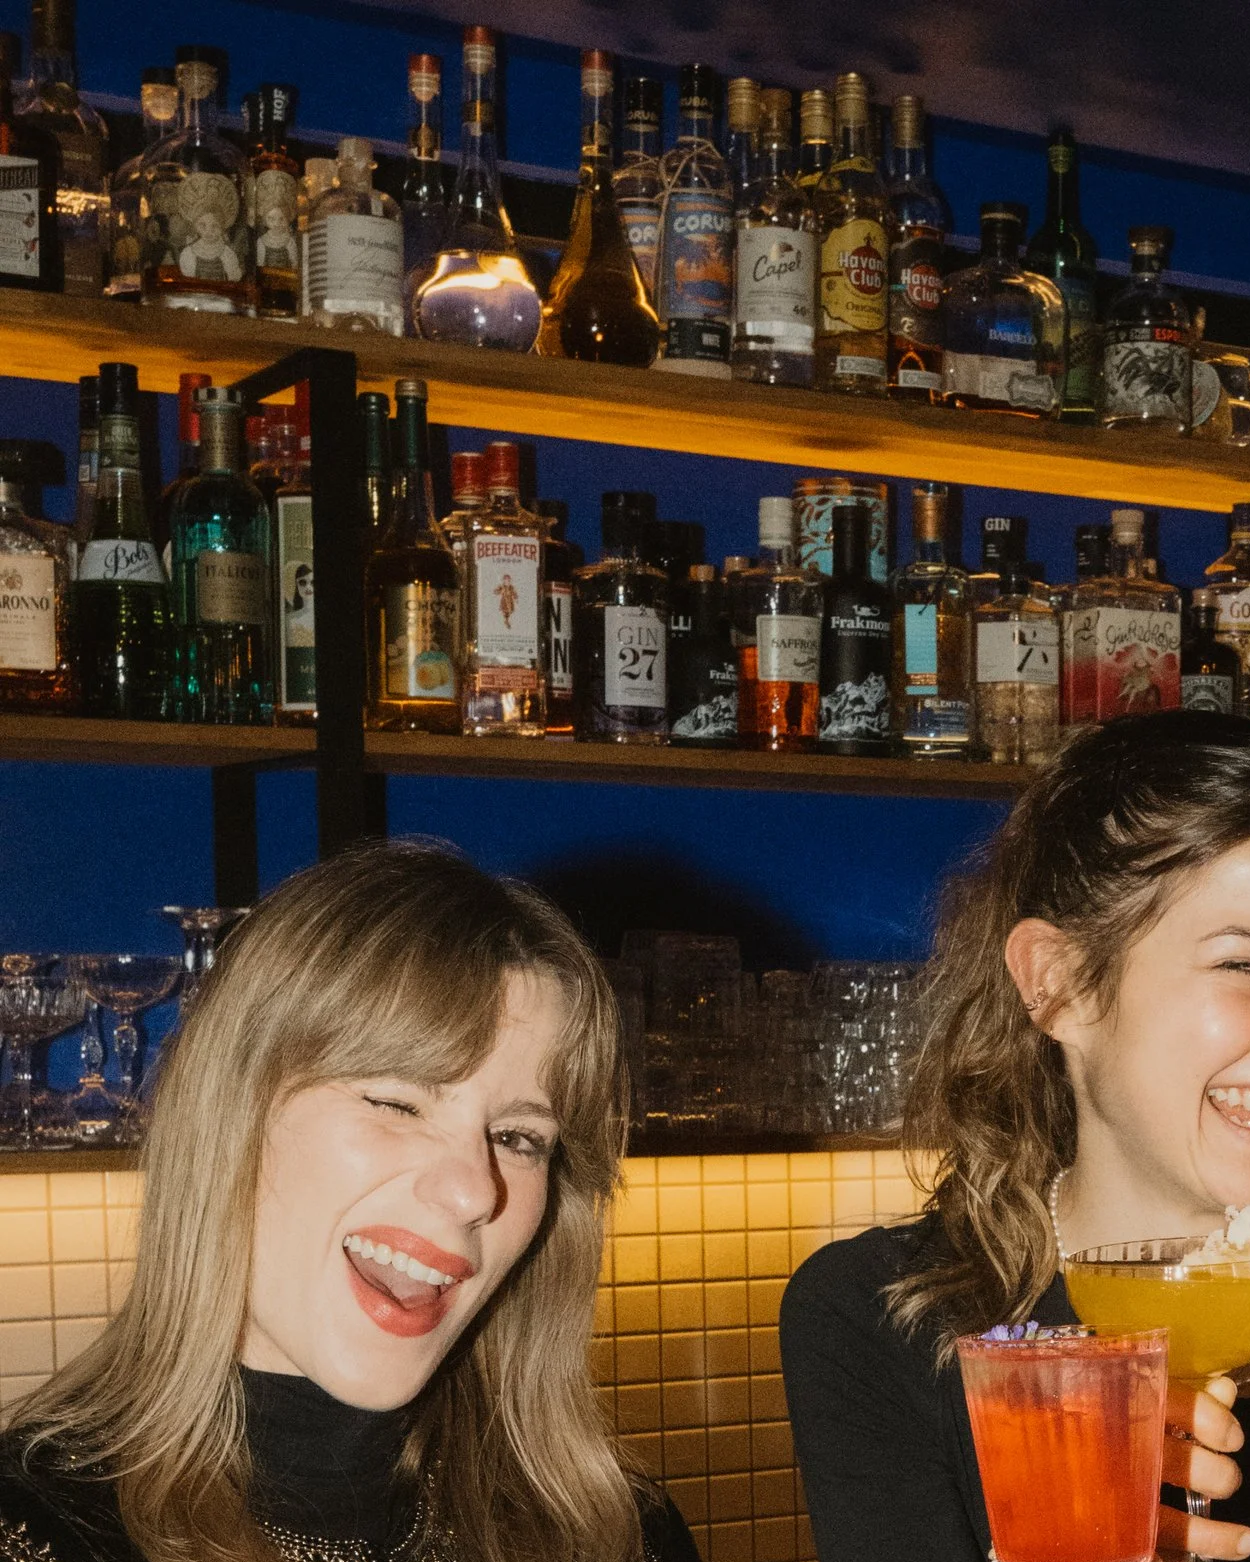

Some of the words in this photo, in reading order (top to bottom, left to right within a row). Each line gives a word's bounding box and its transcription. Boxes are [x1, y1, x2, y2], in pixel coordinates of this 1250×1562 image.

[272, 88, 289, 121] HOF
[851, 269, 881, 288] Club
[985, 517, 1011, 532] GIN
[477, 541, 538, 562] BEEFEATER
[617, 625, 658, 646] GIN
[618, 646, 659, 681] 27
